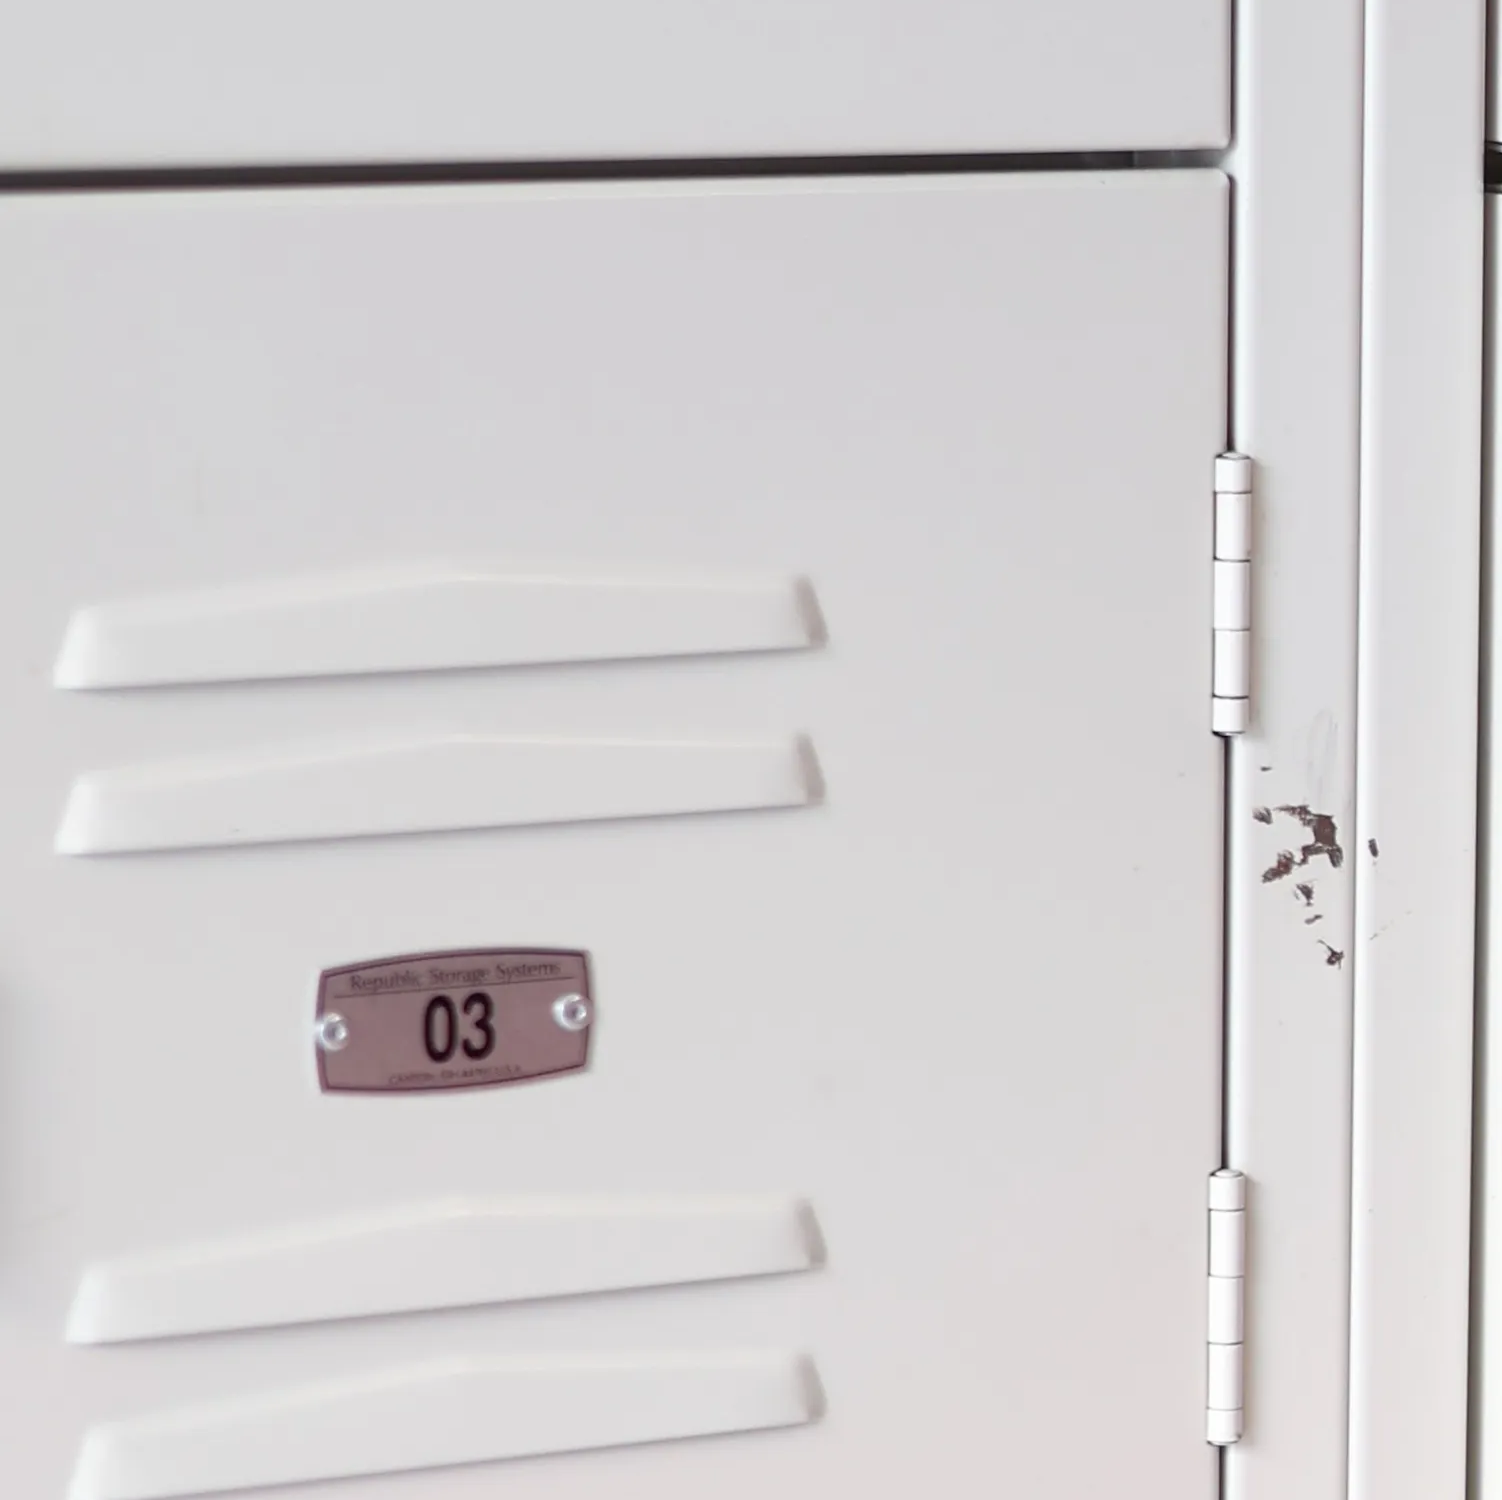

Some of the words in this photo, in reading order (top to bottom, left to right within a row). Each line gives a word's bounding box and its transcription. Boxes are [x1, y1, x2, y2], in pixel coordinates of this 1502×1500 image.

[351, 970, 419, 991] Republic
[429, 967, 491, 985] Storage
[496, 962, 562, 981] Systems
[424, 992, 495, 1063] 03
